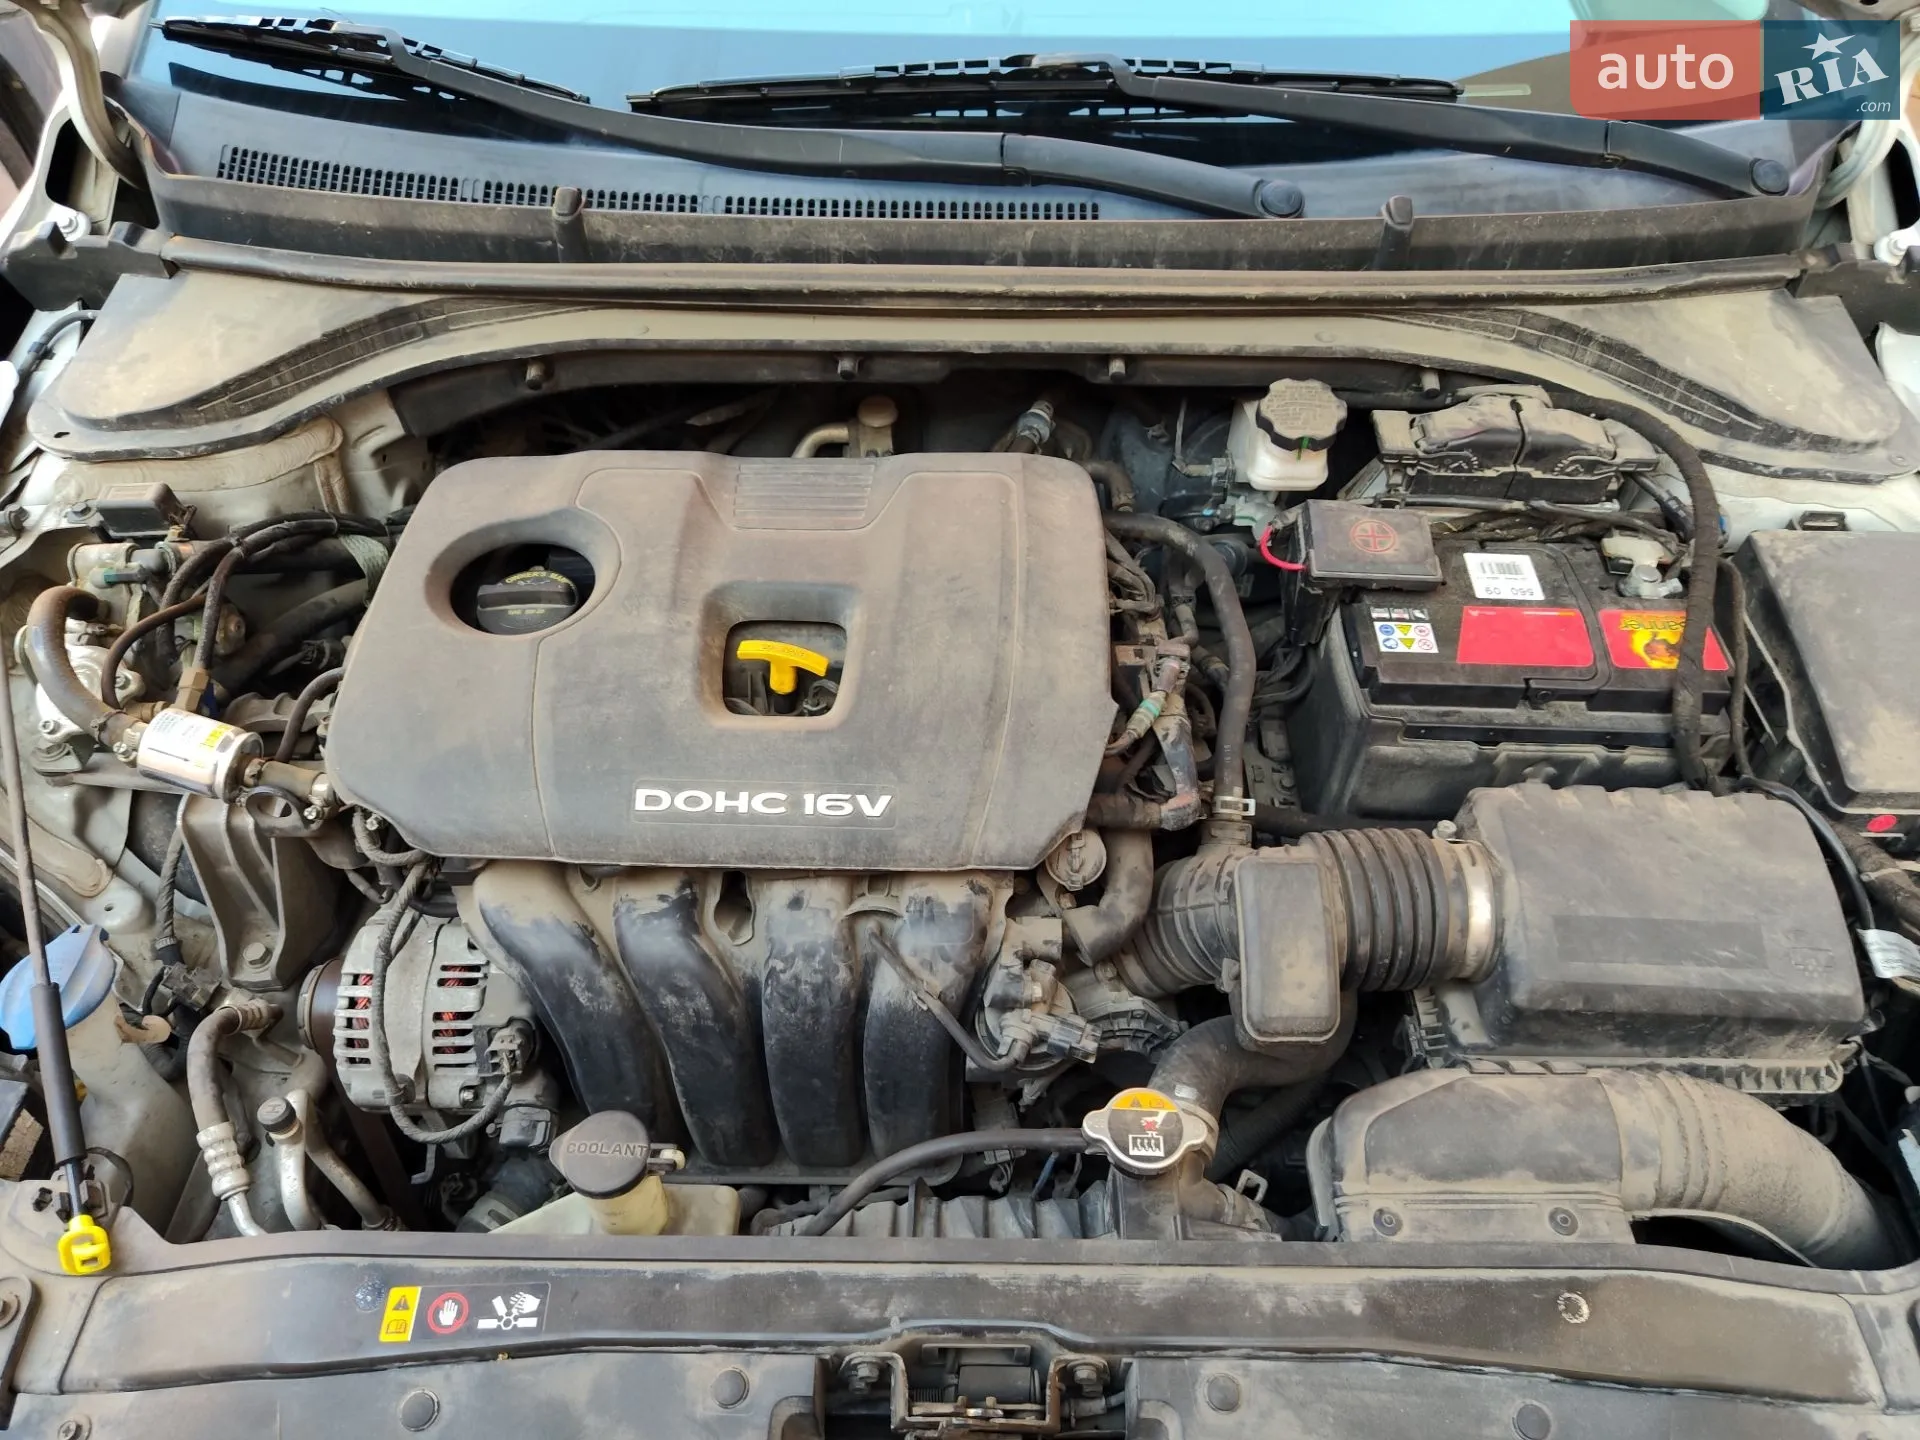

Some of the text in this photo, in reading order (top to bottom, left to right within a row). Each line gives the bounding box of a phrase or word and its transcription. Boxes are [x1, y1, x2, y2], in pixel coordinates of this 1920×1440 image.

[635, 788, 892, 817] DOHC 16V
[566, 1142, 648, 1158] COOLANT
